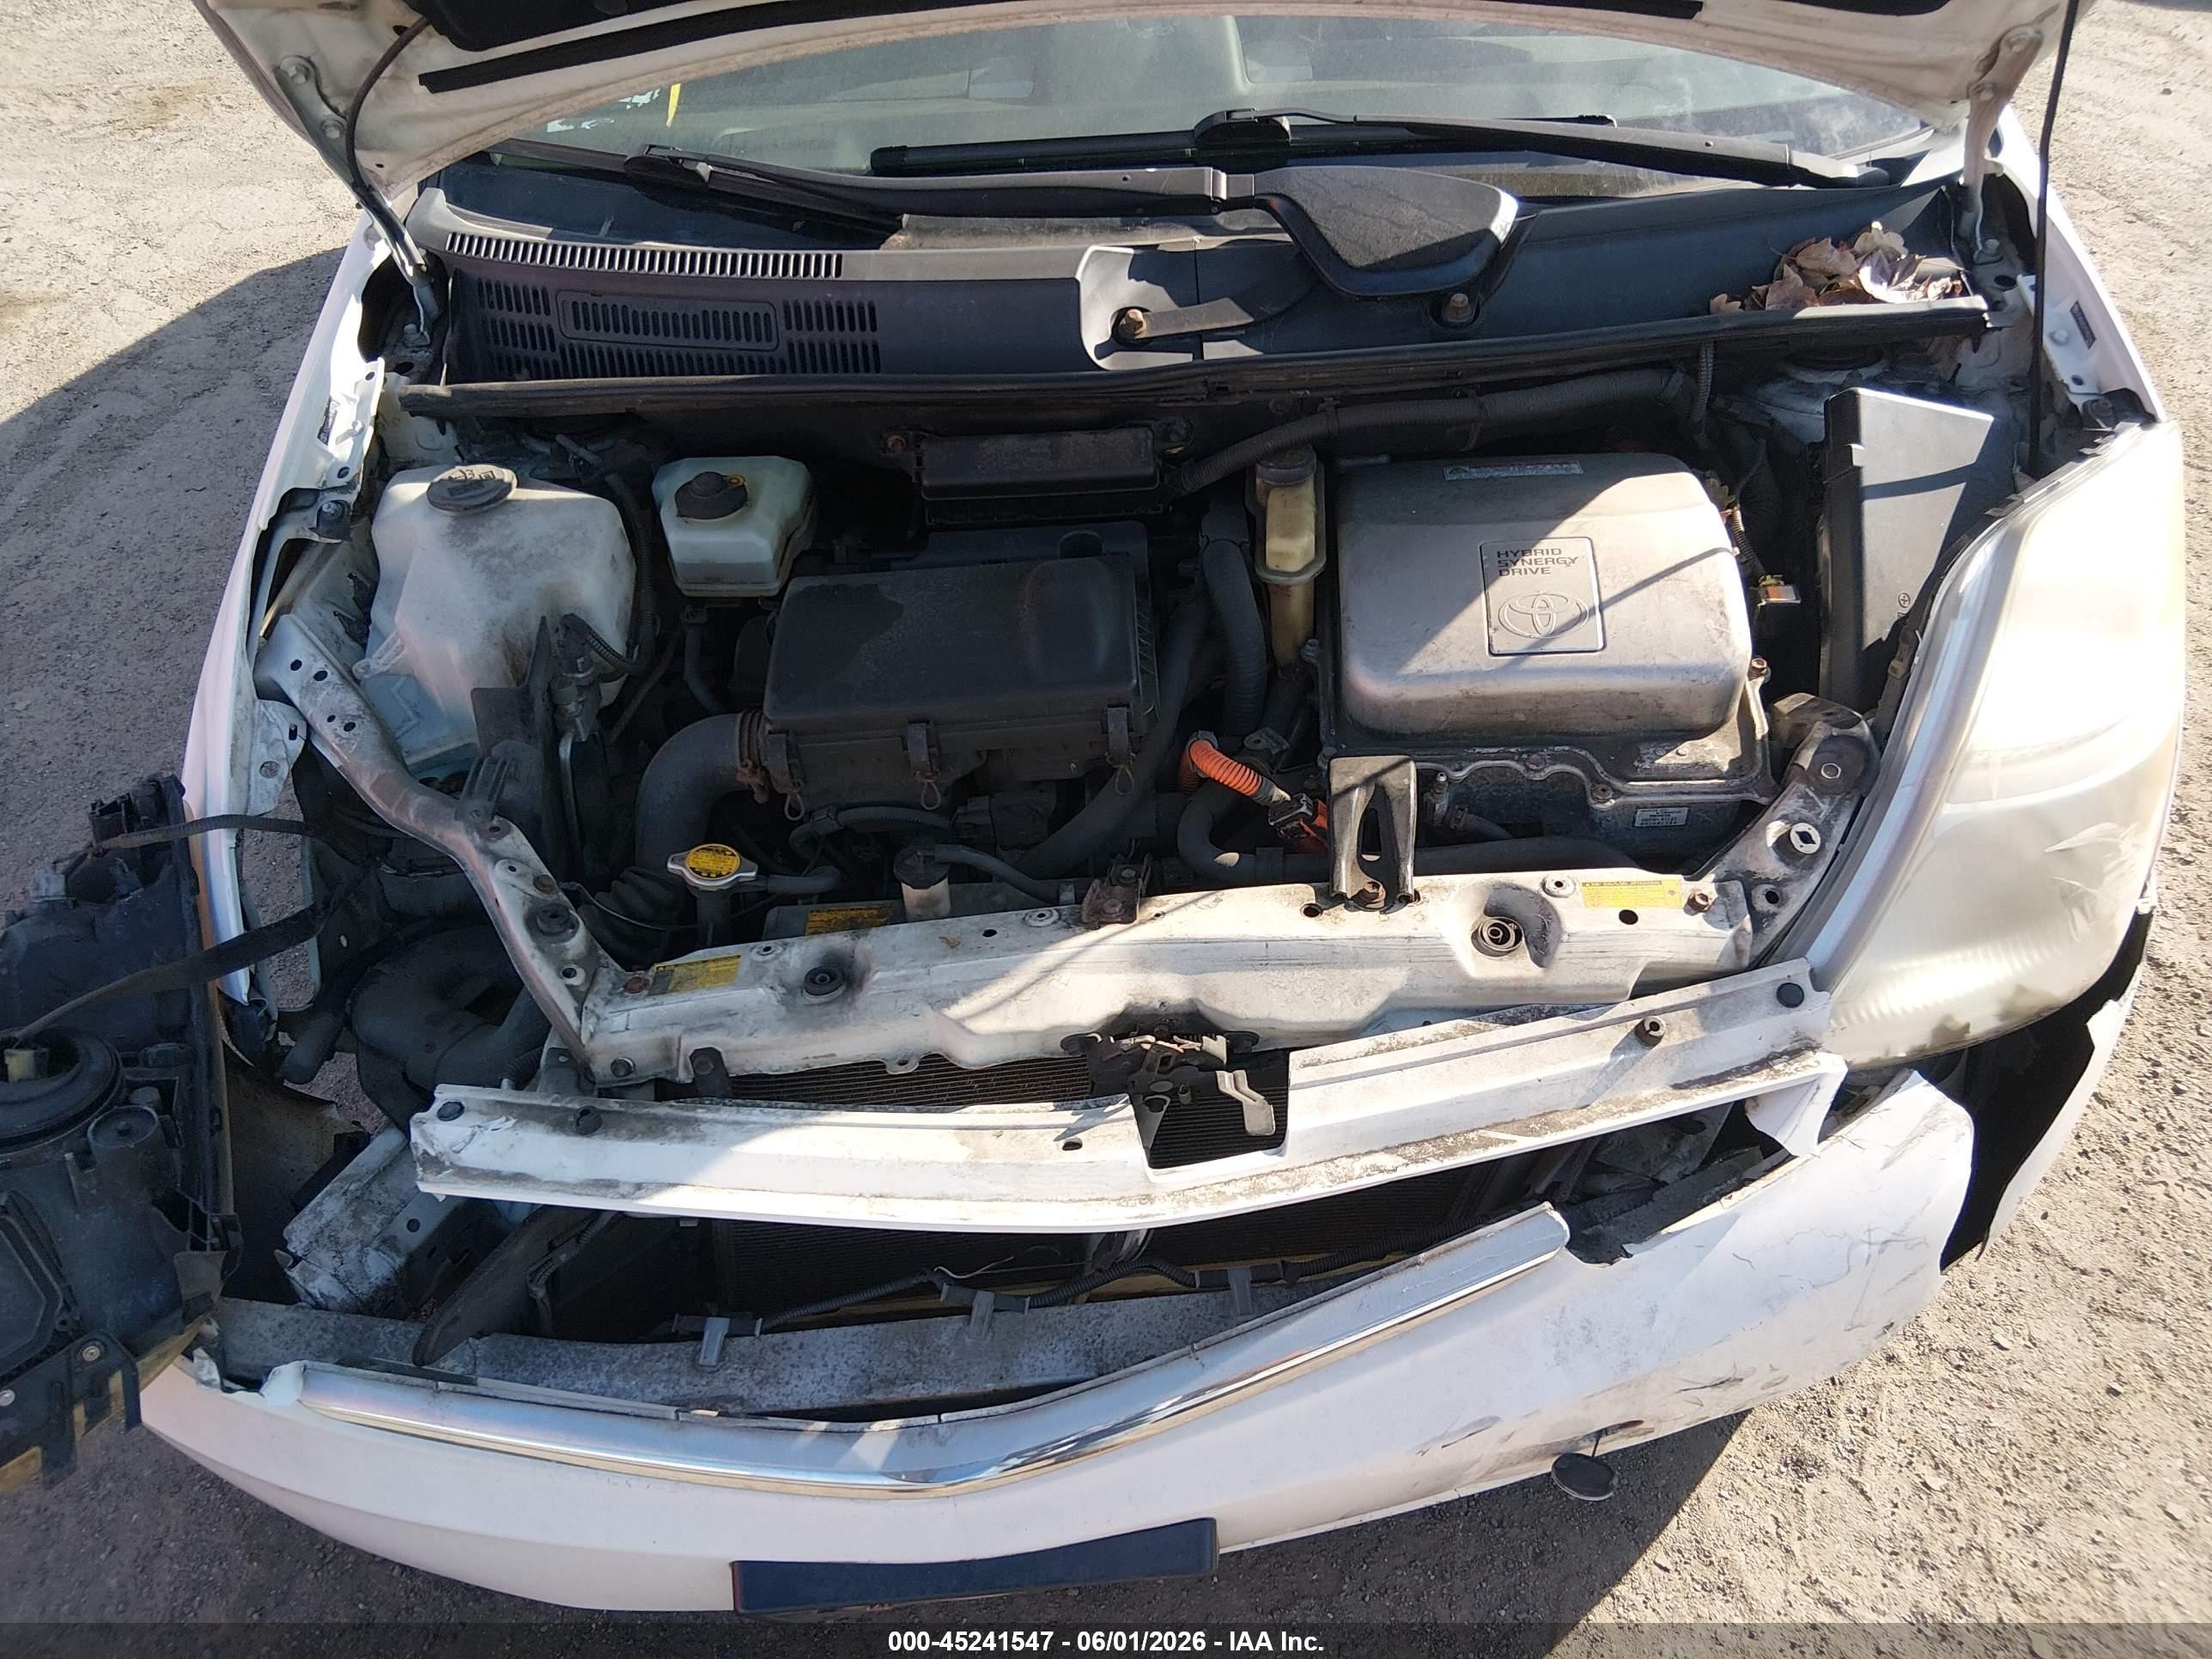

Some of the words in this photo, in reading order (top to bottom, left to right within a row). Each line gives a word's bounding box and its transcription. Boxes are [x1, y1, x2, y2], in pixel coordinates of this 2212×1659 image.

[1497, 548, 1562, 558] HYBRID
[1497, 556, 1578, 568] SYNERGY
[1498, 567, 1552, 577] DRIVE
